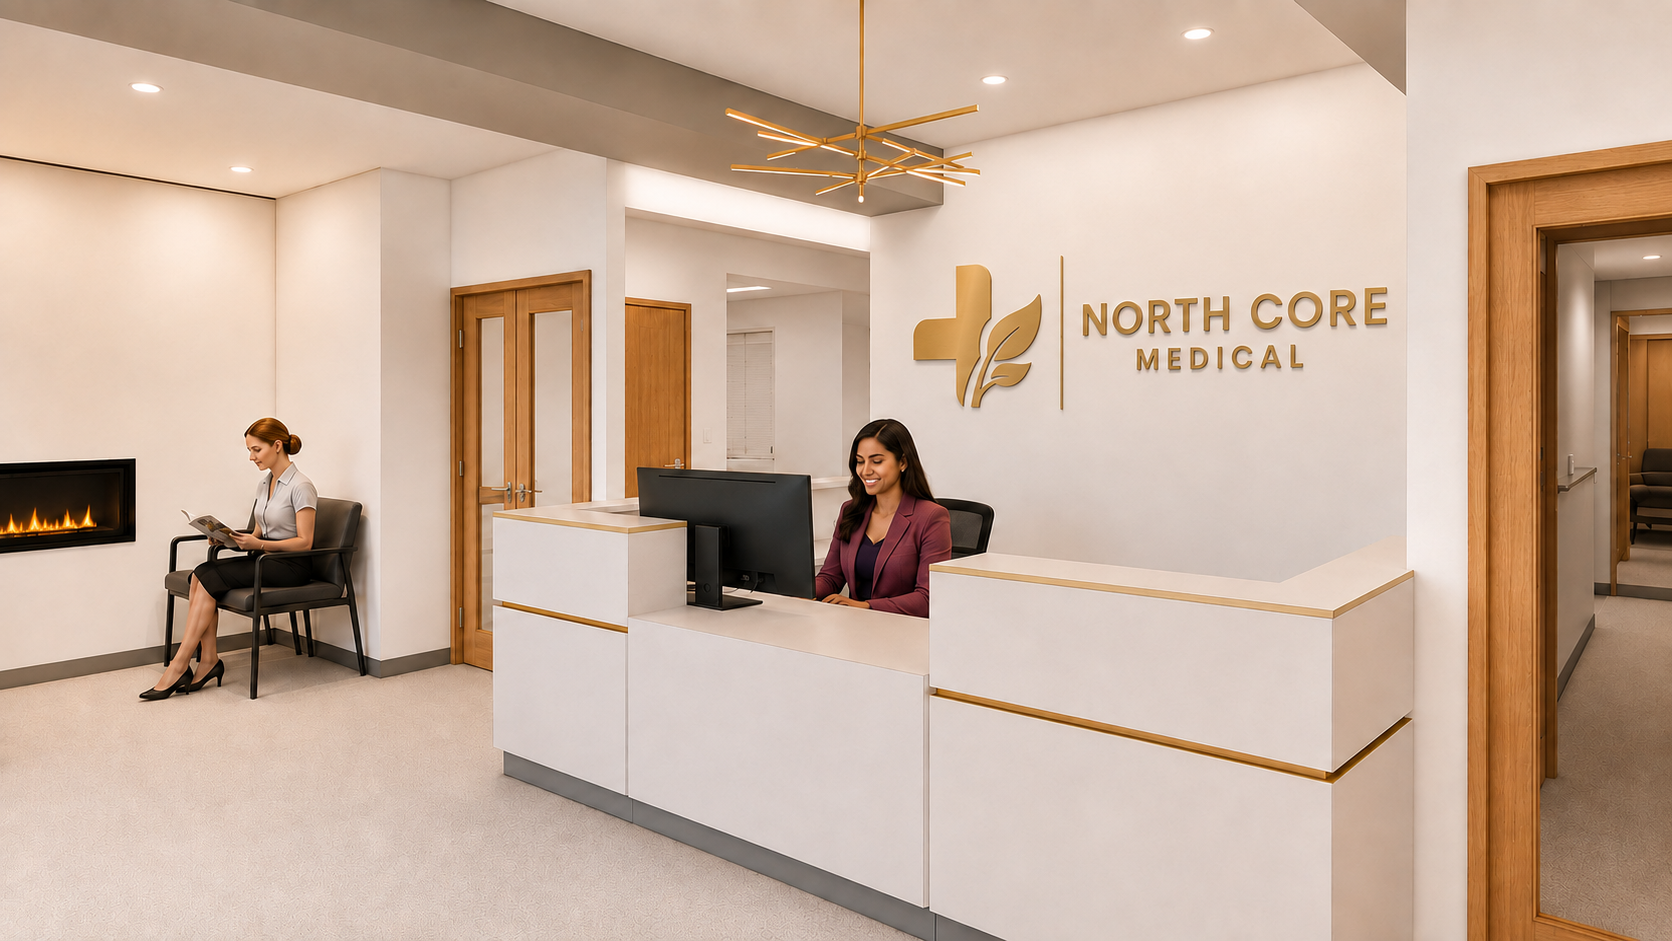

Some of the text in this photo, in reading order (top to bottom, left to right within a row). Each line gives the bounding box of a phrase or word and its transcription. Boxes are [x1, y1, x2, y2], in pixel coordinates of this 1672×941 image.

[1082, 286, 1389, 337] NORTH CORE
[1136, 344, 1304, 371] MEDICAL
